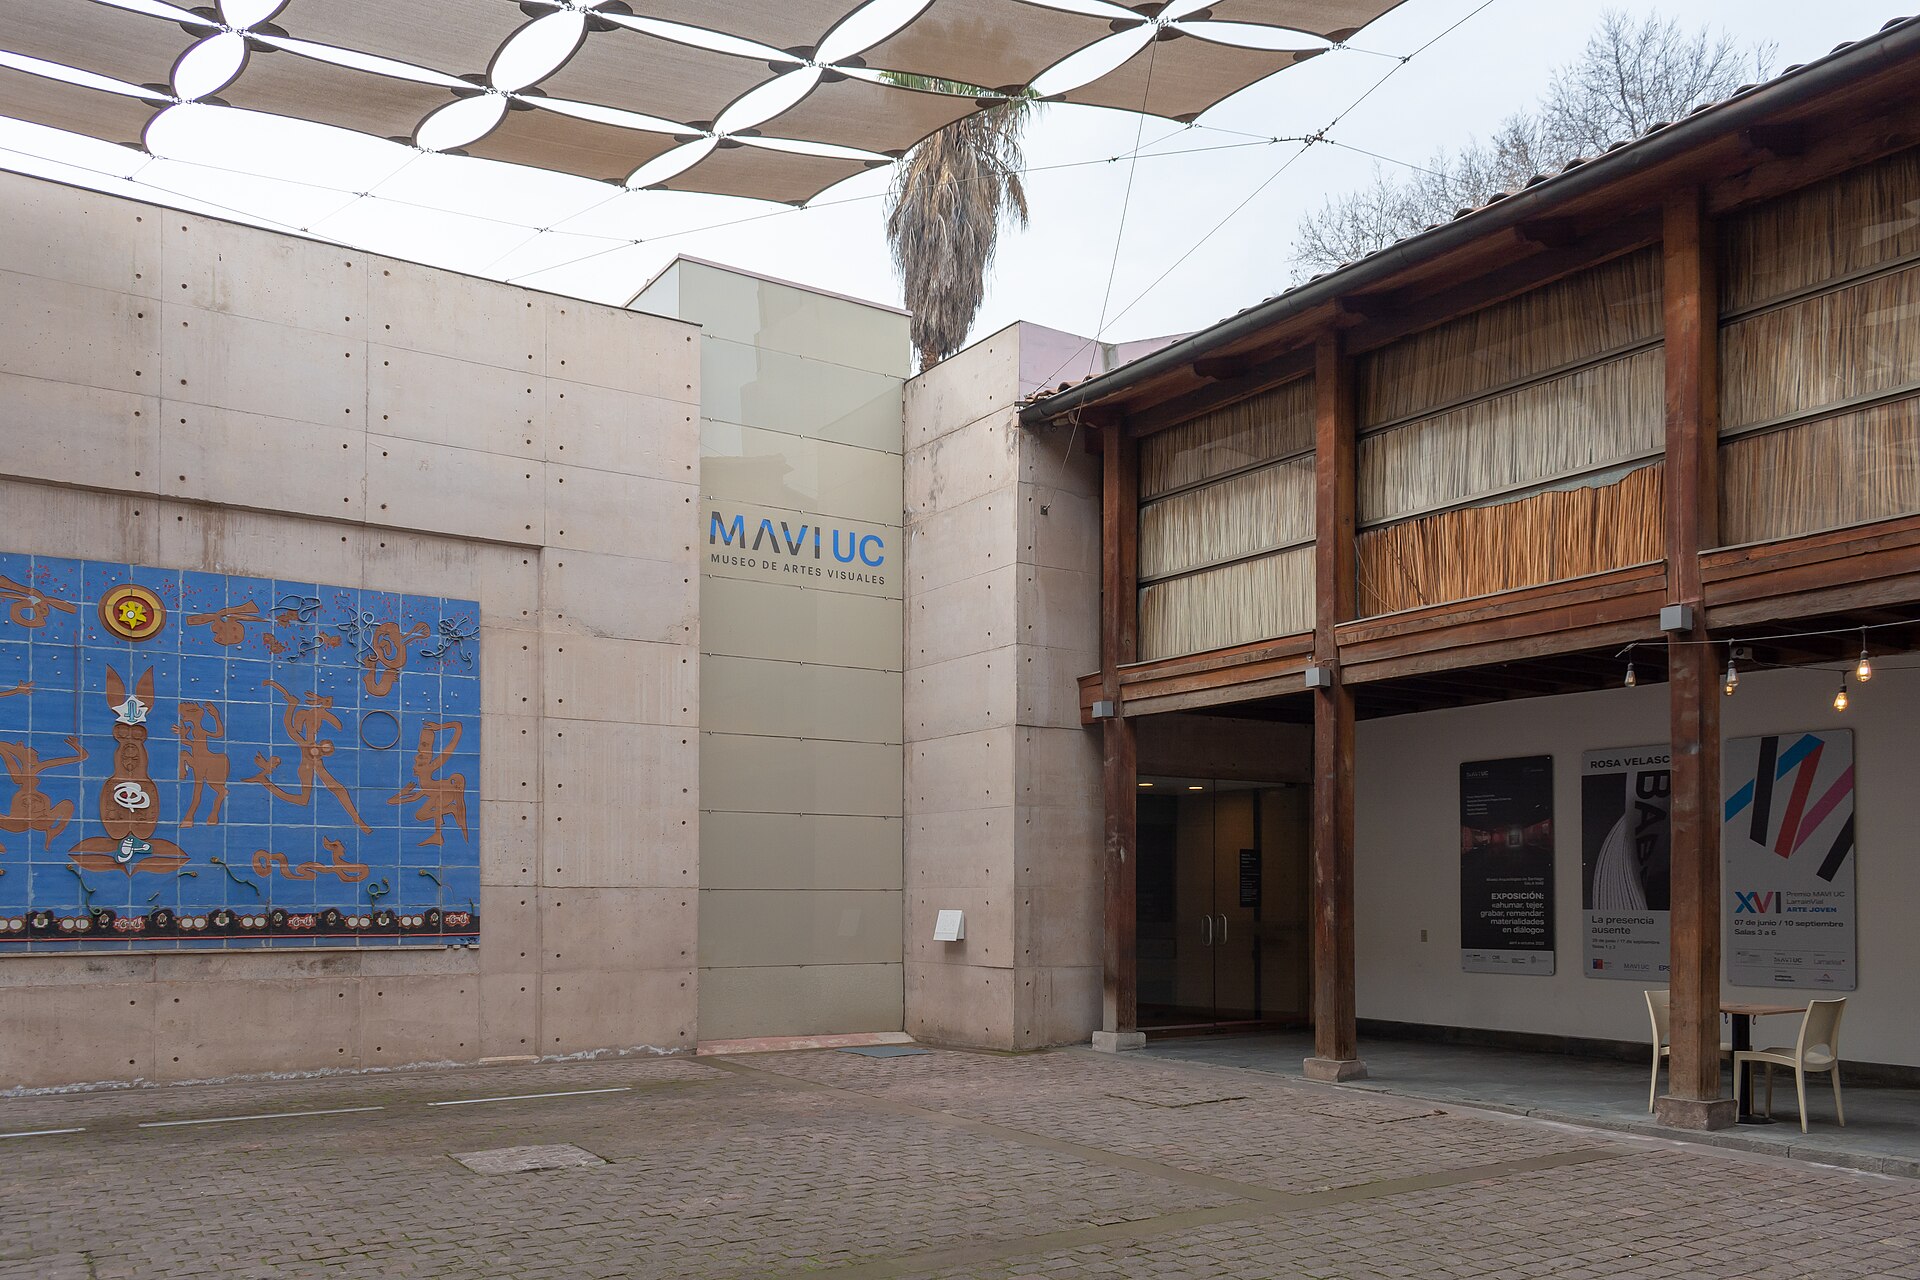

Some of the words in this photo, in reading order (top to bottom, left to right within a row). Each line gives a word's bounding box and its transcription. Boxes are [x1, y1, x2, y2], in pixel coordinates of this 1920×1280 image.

[709, 511, 820, 559] MAVI
[833, 530, 884, 567] UC
[711, 553, 756, 568] MUSEO
[762, 560, 777, 571] DE
[783, 563, 821, 577] ARTES
[827, 569, 885, 585] VISUALES
[1590, 760, 1621, 769] ROSA
[1624, 755, 1670, 766] VELASC
[1491, 891, 1544, 900] EXPOSICIÓN:
[1491, 902, 1525, 910] «ahumar,
[1526, 902, 1544, 910] tejer,
[1735, 891, 1782, 914] XVI
[1480, 910, 1505, 918] grabar,
[1591, 915, 1604, 924] La
[1605, 916, 1655, 925] presencia
[1757, 920, 1777, 928] junio
[1795, 920, 1844, 928] septiembre
[1513, 926, 1544, 935] diálogo»
[1591, 926, 1631, 934] ausente
[1734, 928, 1756, 936] Salas
